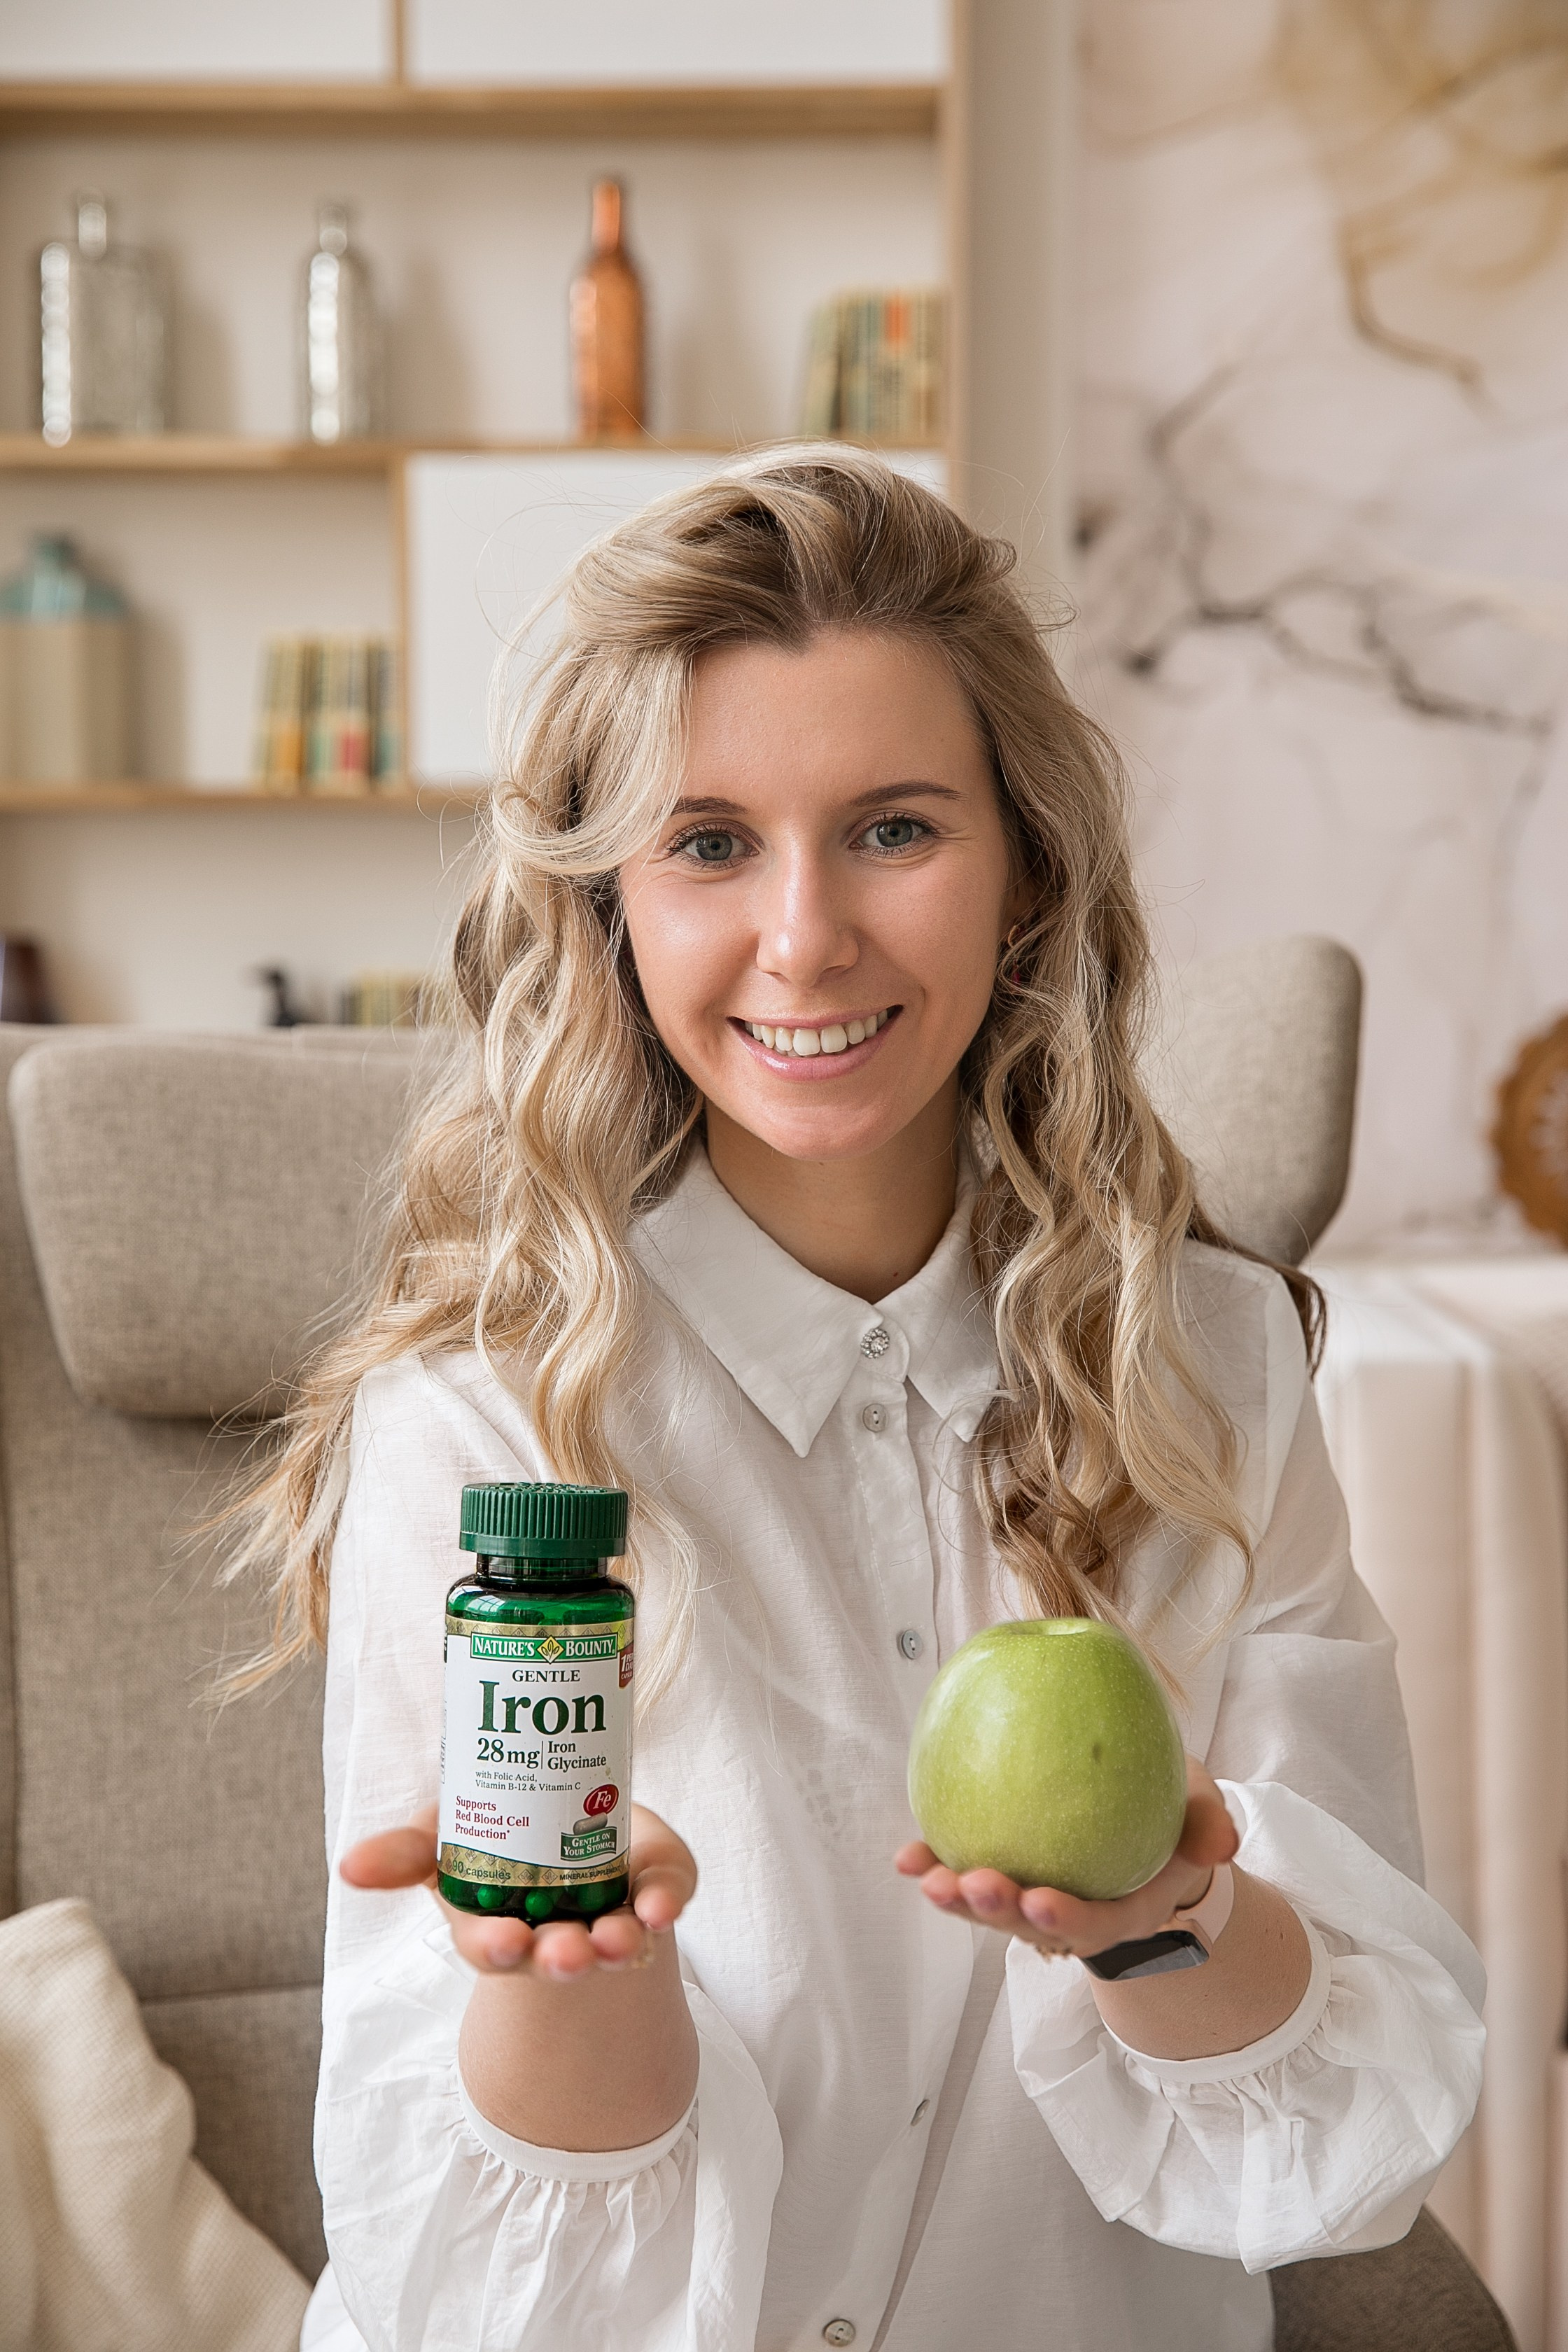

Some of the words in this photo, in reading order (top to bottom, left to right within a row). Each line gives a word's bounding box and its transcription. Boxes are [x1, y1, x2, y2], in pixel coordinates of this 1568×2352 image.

[474, 1637, 535, 1657] NATURE'S
[512, 1669, 580, 1683] GENTLE
[477, 1680, 607, 1735] Iron
[548, 1741, 576, 1753] Iron
[547, 1755, 607, 1772] Glycinate
[476, 1770, 492, 1779] with
[493, 1772, 513, 1781] Folic
[514, 1773, 538, 1782] Acid,
[475, 1779, 506, 1790] Vitamin
[456, 1795, 496, 1811] Supports
[593, 1791, 612, 1809] Fe
[456, 1809, 471, 1821] Red
[474, 1812, 503, 1826] Blood
[507, 1816, 530, 1826] Cell
[572, 1835, 600, 1847] GENTLE
[564, 1846, 584, 1856] YOUR
[587, 1842, 615, 1854] STOMACH
[452, 1860, 464, 1874] 90
[465, 1868, 511, 1880] capsules
[559, 1872, 589, 1881] MINERAL
